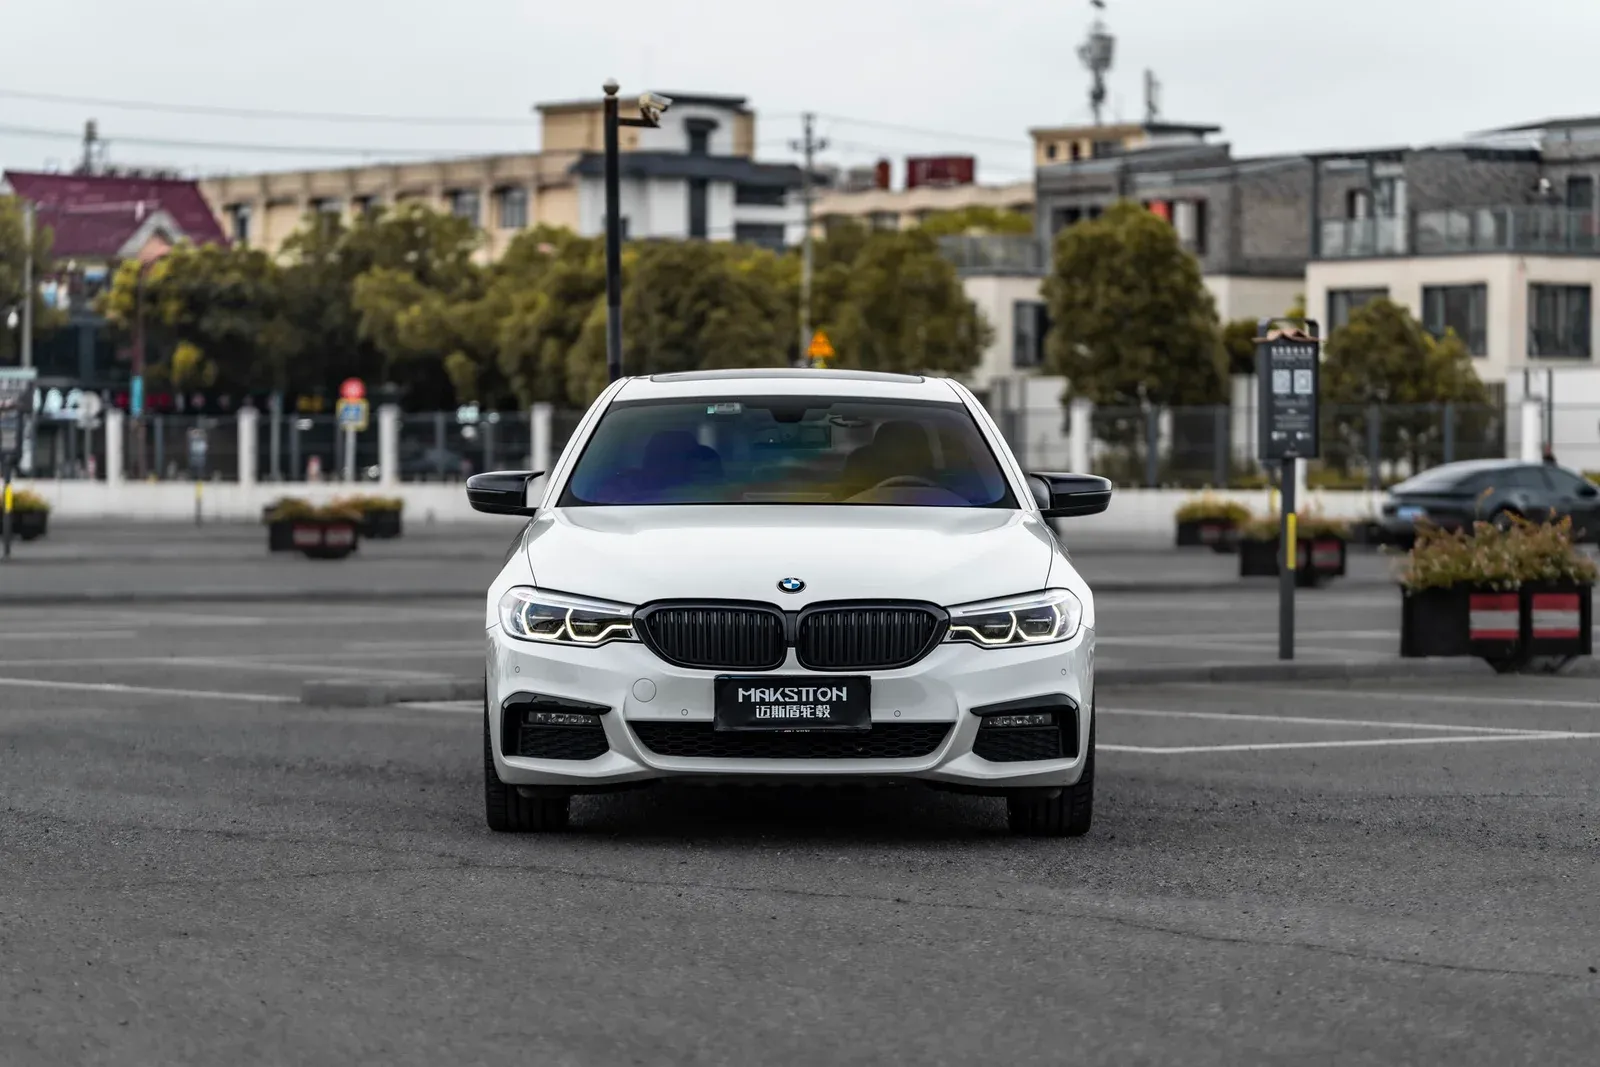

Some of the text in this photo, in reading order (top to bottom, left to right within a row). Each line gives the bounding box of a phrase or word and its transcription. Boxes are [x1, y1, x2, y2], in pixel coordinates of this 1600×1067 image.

[756, 704, 831, 719] 迈斯盾轮毂
